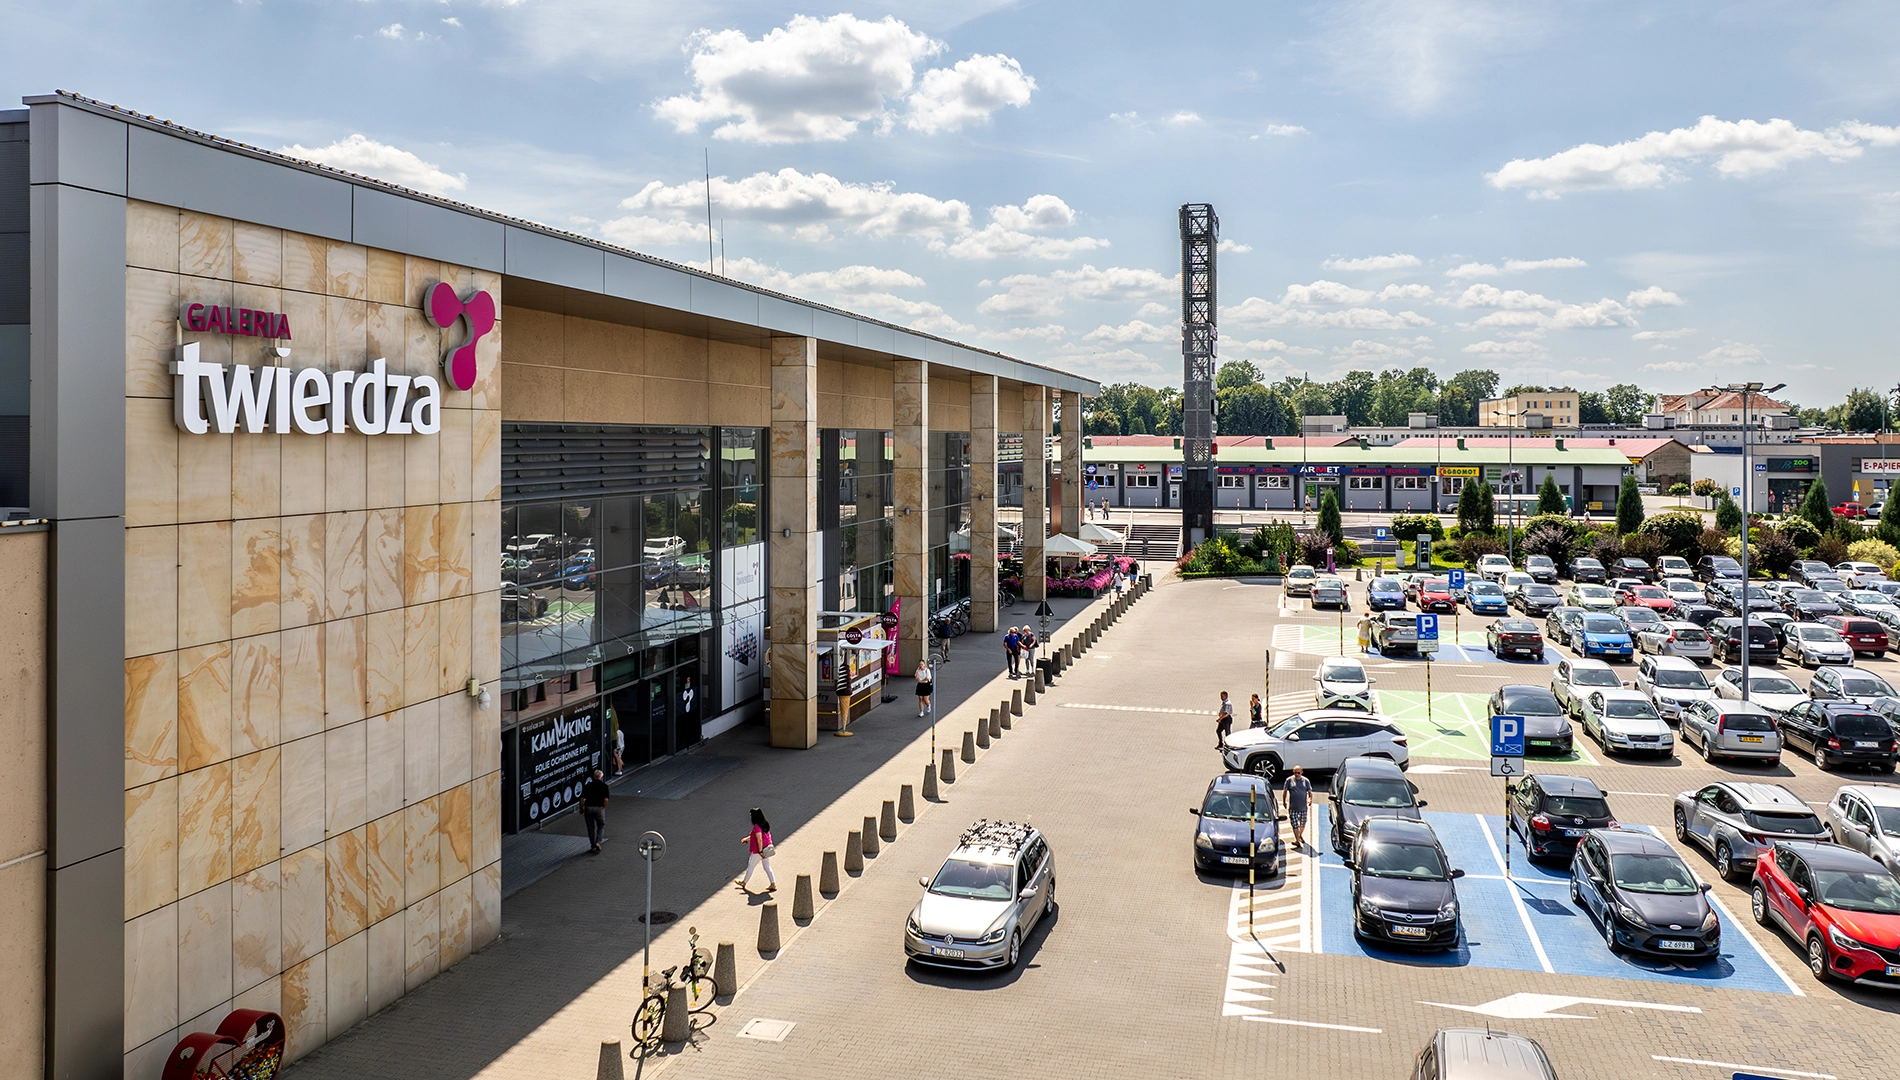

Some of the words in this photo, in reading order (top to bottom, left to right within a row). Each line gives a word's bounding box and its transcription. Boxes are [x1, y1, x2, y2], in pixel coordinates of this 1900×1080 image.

[184, 302, 292, 341] GALERIA
[172, 340, 441, 436] twierdza
[1452, 571, 1462, 583] P
[1421, 616, 1434, 633] P
[531, 728, 556, 754] KAM
[568, 714, 592, 739] KING
[1499, 719, 1518, 744] P
[535, 760, 551, 774] FOLIE
[550, 747, 580, 767] OCHRONNE
[1494, 744, 1504, 752] 2x
[1663, 940, 1673, 948] LZ
[1674, 941, 1694, 949] 69813
